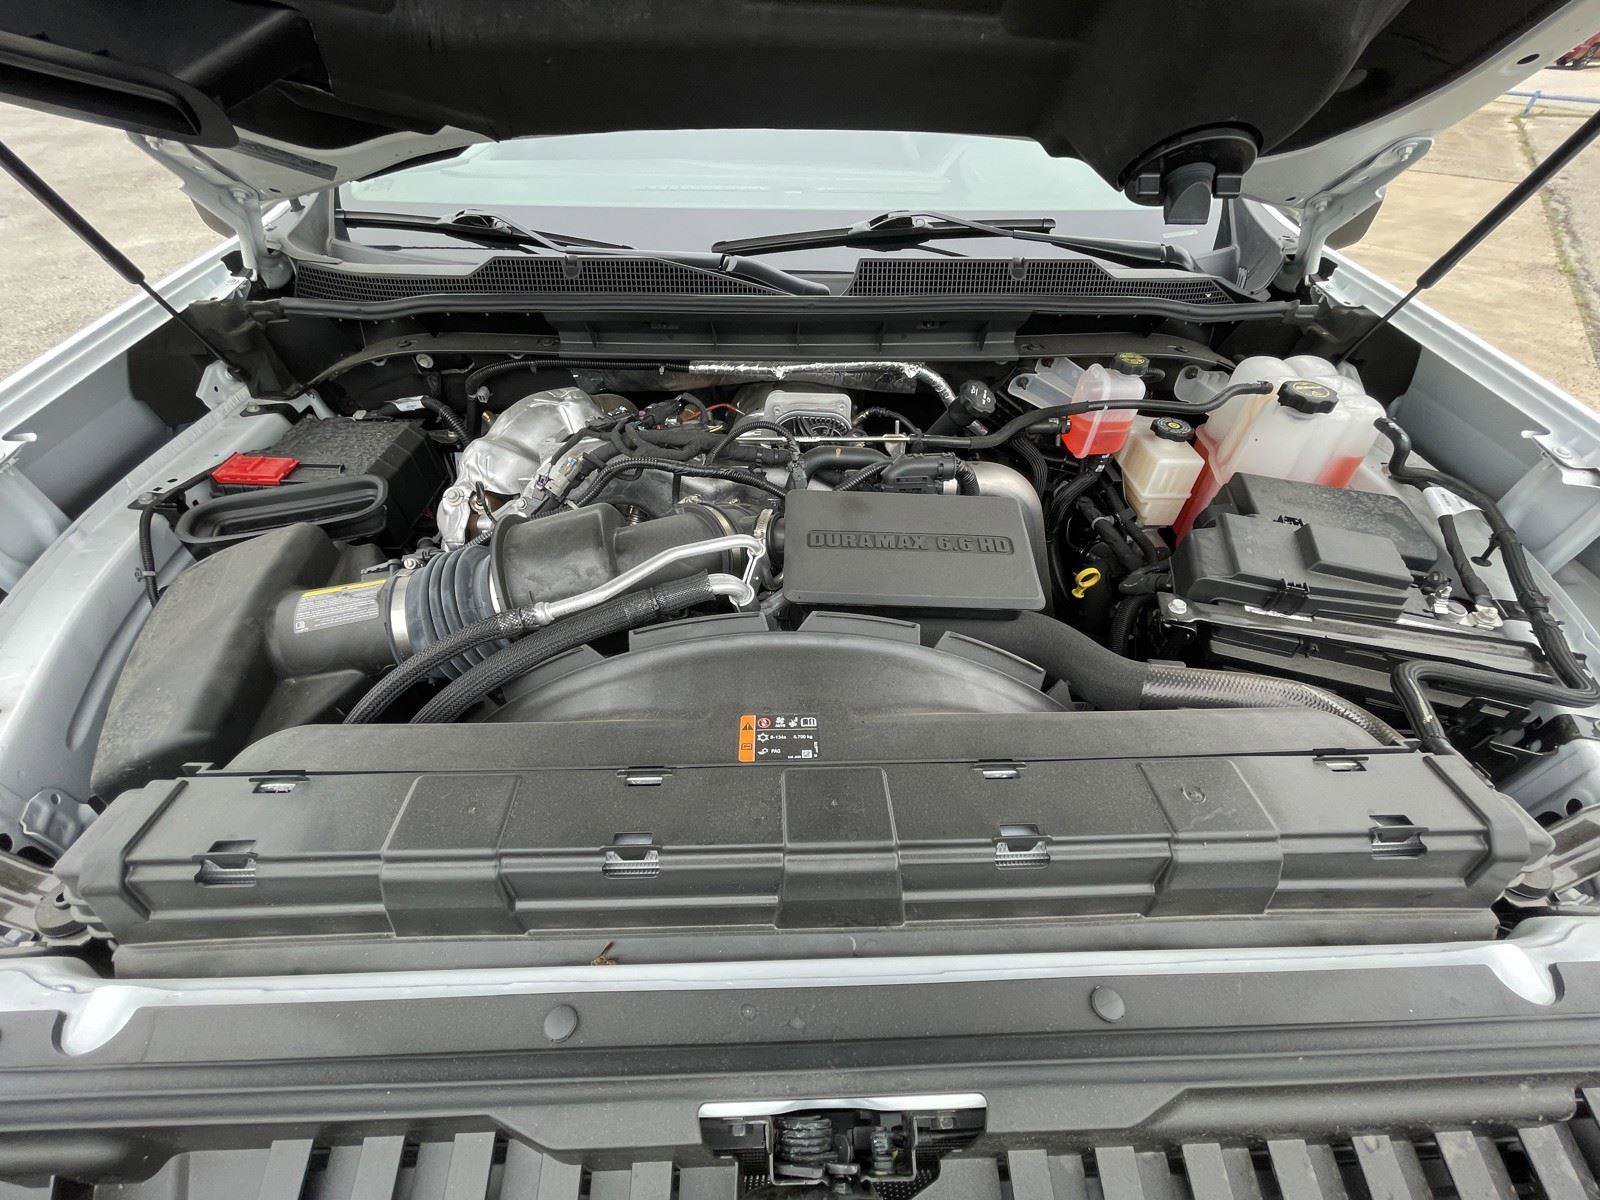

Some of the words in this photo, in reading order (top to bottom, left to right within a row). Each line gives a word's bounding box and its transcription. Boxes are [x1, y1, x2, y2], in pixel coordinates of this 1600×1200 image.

[809, 532, 928, 550] DURAMAX
[936, 536, 976, 552] 6.6
[979, 537, 1012, 553] HD
